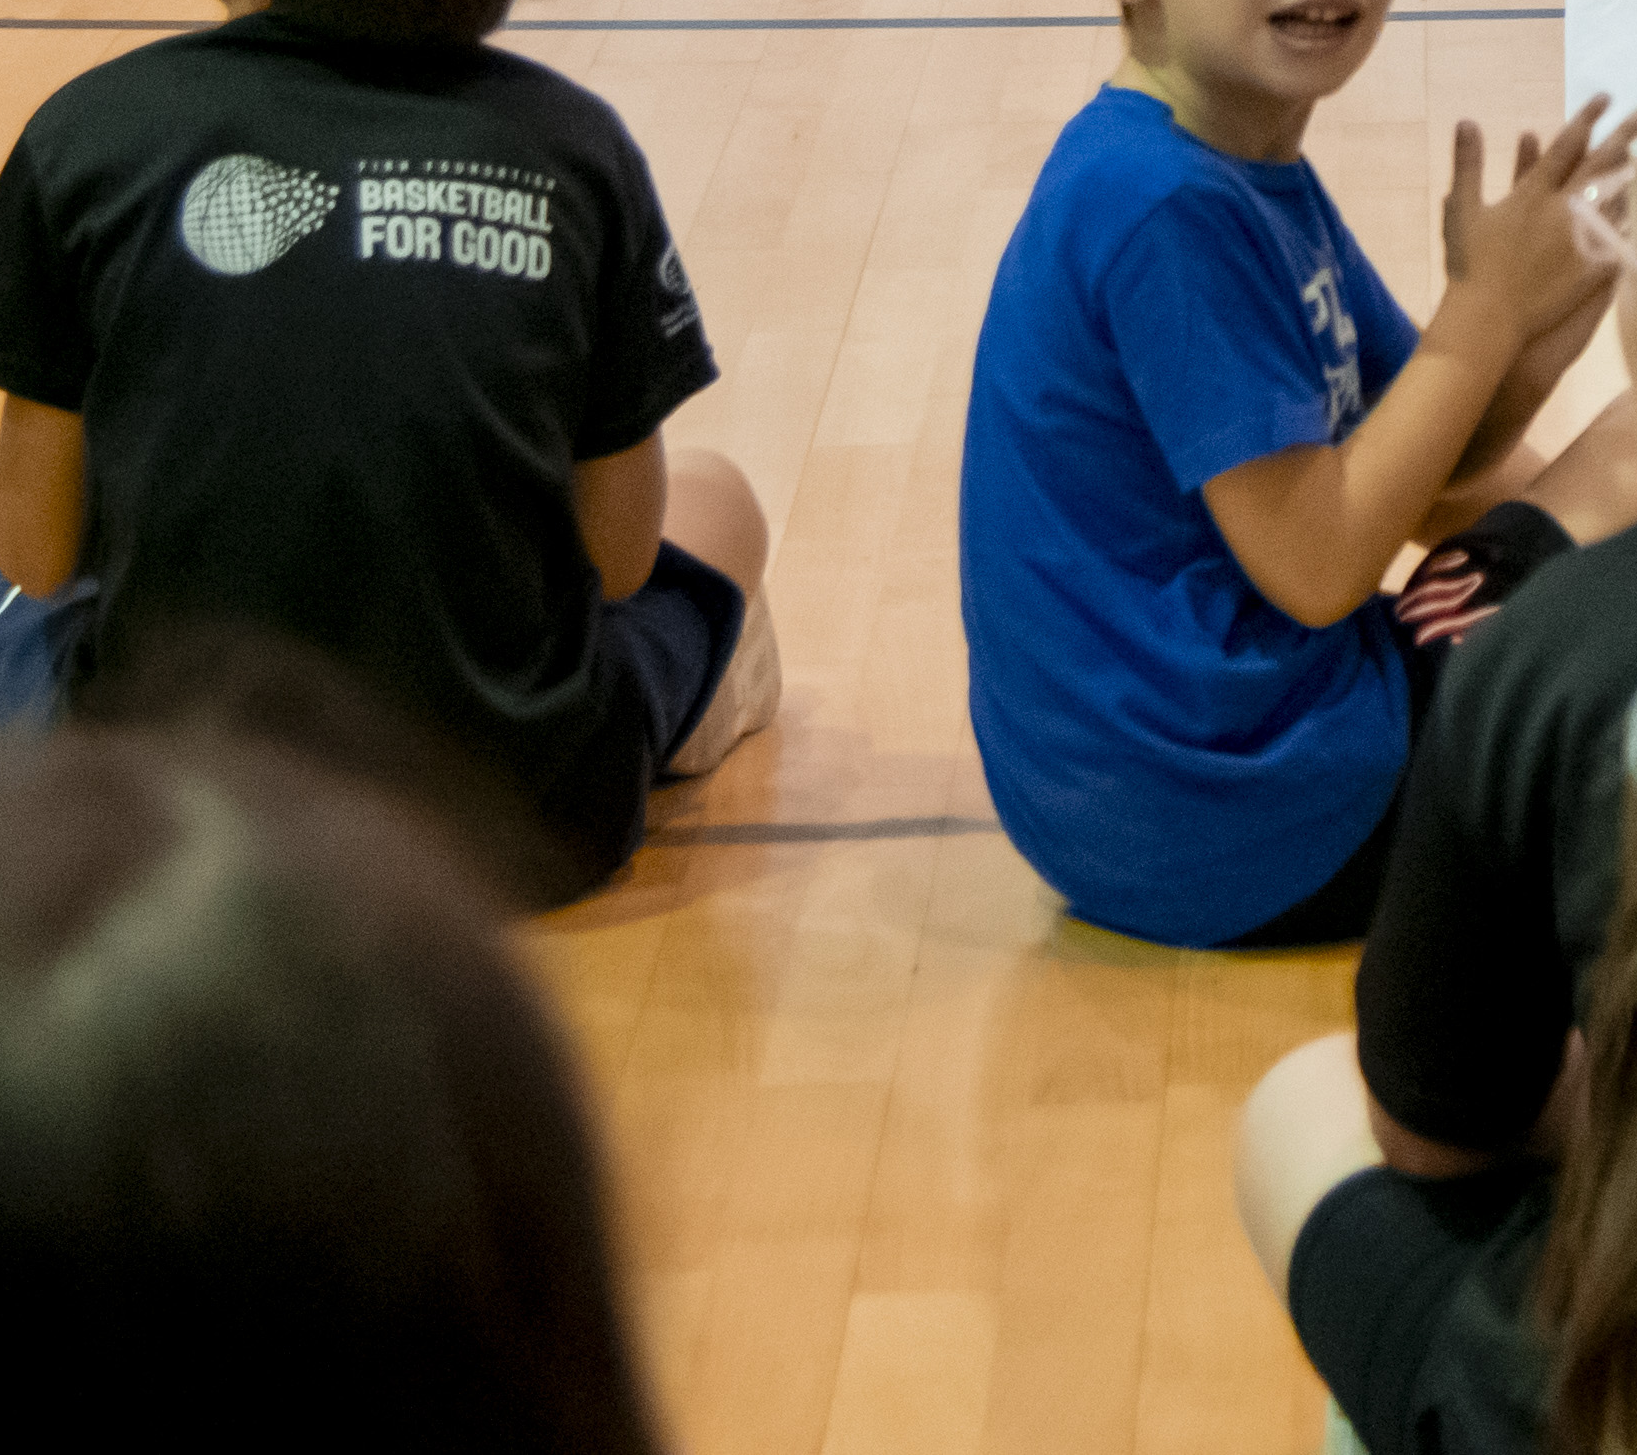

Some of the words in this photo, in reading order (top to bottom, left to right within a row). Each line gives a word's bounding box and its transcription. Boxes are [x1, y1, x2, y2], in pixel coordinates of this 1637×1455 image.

[359, 178, 554, 234] BASKETBALL
[360, 214, 442, 260] FOR
[452, 219, 552, 280] GOOD
